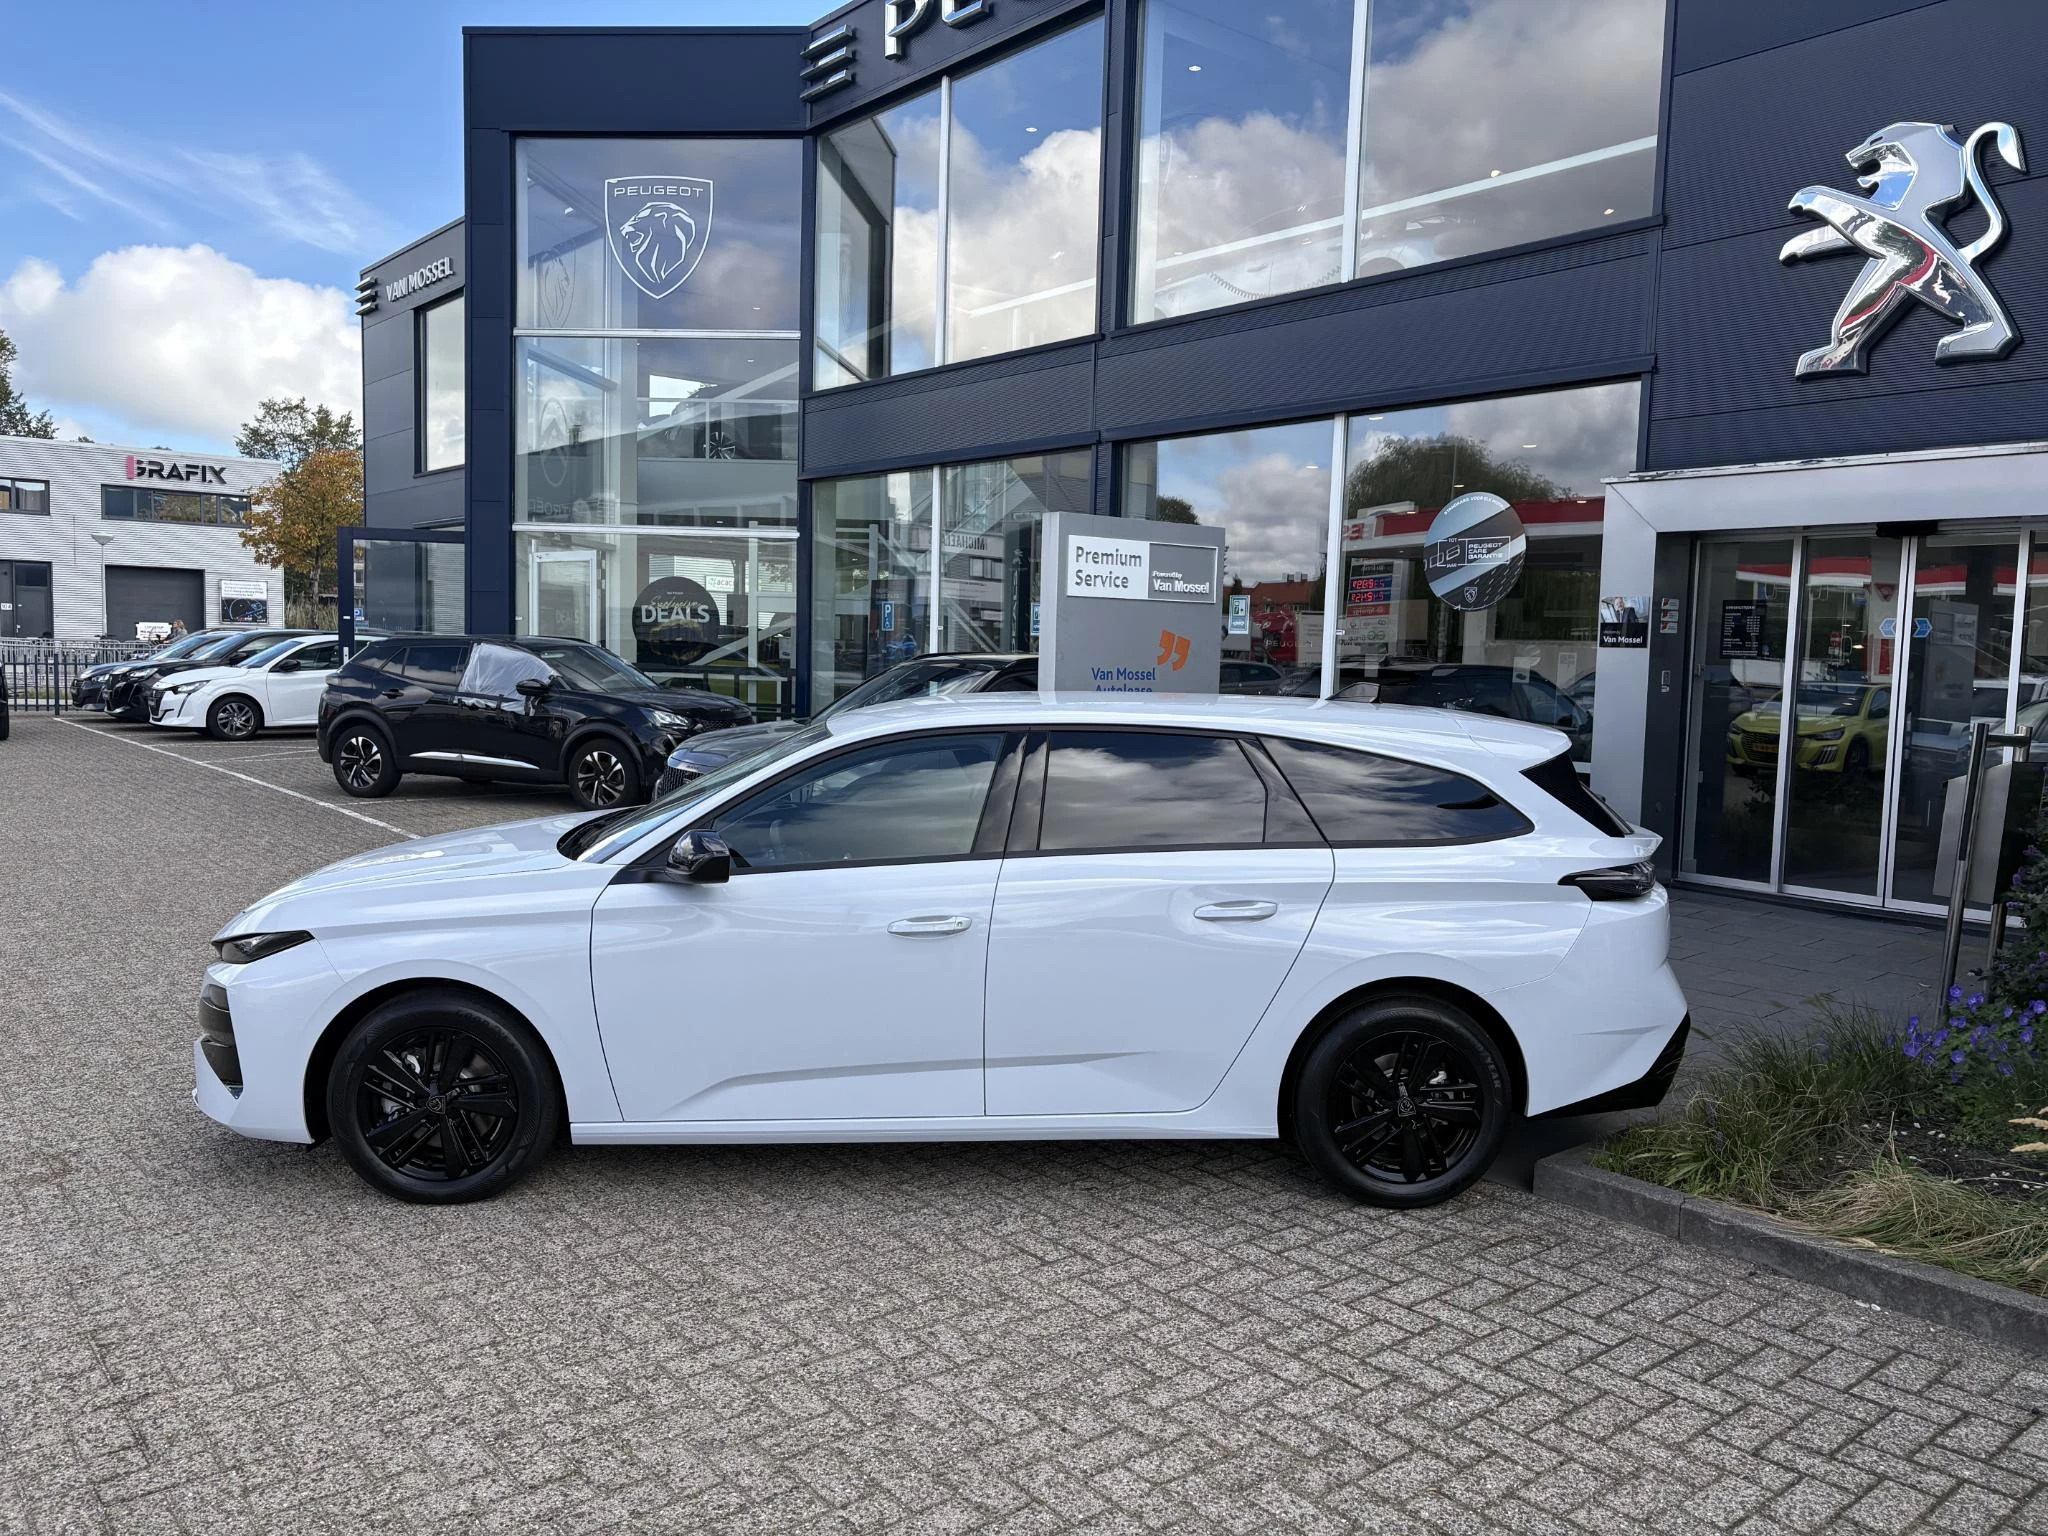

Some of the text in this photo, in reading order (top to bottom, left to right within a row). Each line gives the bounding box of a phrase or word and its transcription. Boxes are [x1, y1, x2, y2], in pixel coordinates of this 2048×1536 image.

[614, 185, 703, 197] PEUGEOT
[386, 256, 454, 302] VAN MOSSEL
[1075, 546, 1142, 567] Premium
[1074, 569, 1129, 589] Service
[1153, 579, 1209, 594] Van Mossel
[641, 604, 710, 623] DEALS
[1603, 635, 1643, 644] Van Mossel
[1091, 667, 1156, 681] Van Mossel
